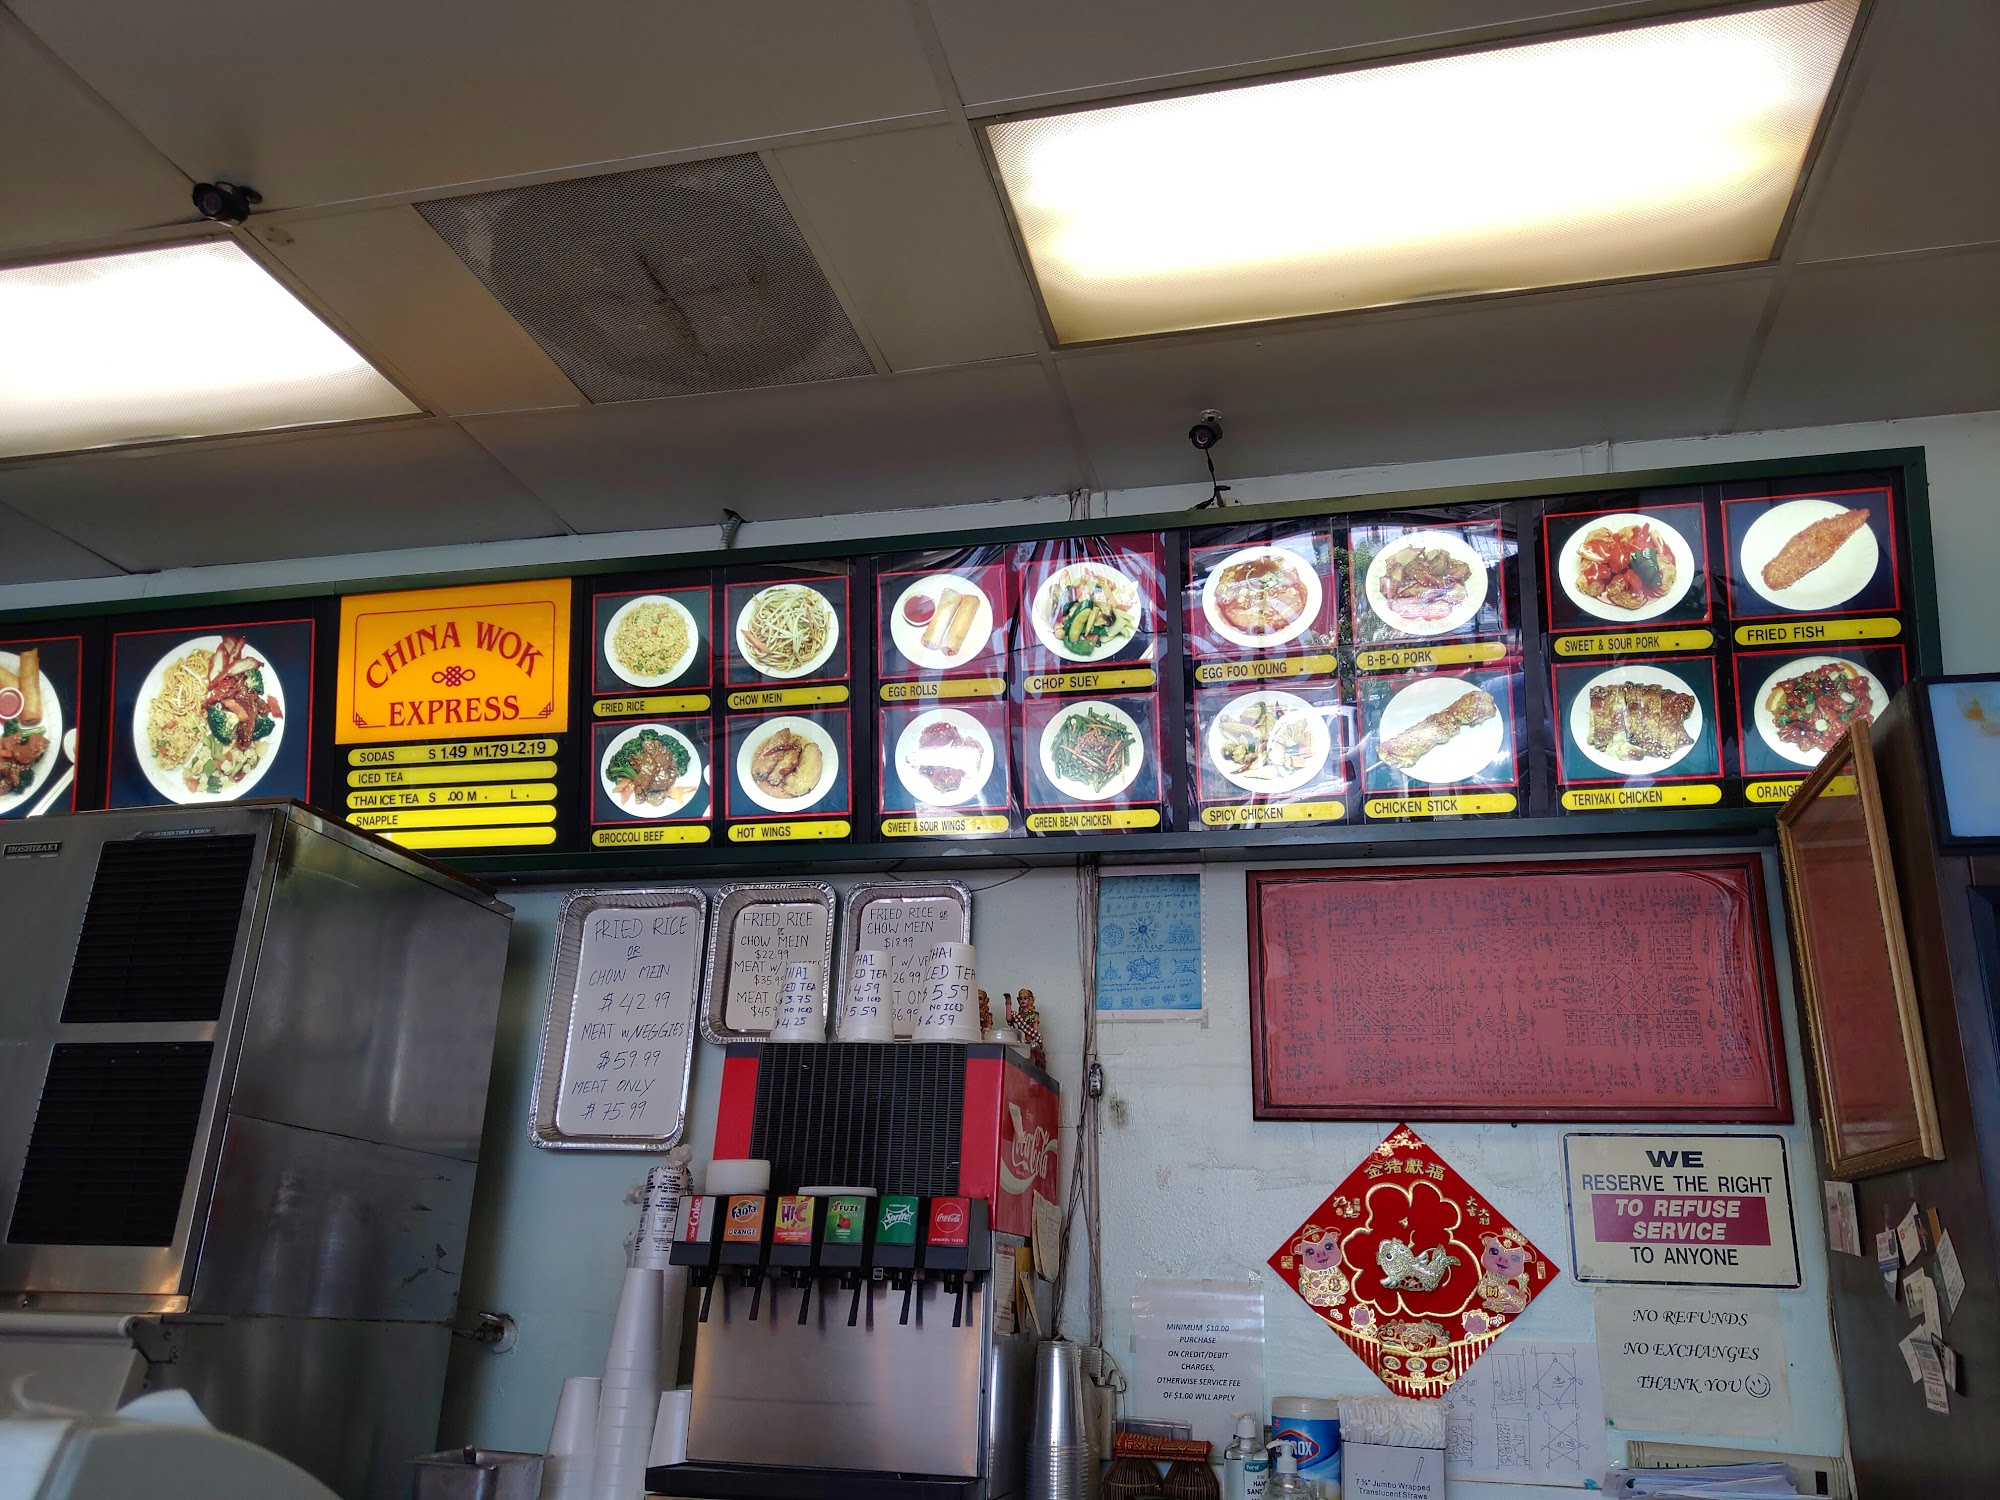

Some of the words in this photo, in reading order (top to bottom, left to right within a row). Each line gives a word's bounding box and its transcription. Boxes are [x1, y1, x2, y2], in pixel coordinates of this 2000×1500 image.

[1748, 629, 1787, 641] FRIED
[1794, 626, 1825, 638] FISH
[1565, 640, 1594, 652] SWEET
[1599, 640, 1604, 650] &
[1608, 638, 1632, 651] SOUR
[1636, 637, 1660, 648] PORK
[366, 621, 461, 688] CHINA
[476, 621, 544, 678] WOK
[1367, 654, 1399, 667] B-B-Q
[1404, 652, 1432, 663] PORK
[1202, 667, 1223, 679] EGG
[1227, 664, 1249, 677] FOO
[1253, 662, 1287, 675] YOUNG
[1034, 678, 1065, 690] CHOP
[1069, 675, 1099, 687] SUEY
[888, 686, 907, 697] EGG
[910, 685, 938, 696] ROLLS
[734, 695, 759, 706] CHOW
[762, 693, 782, 704] MEIN
[389, 695, 520, 727] EXPRESS
[601, 702, 624, 713] FRIED
[627, 701, 645, 712] RICE
[360, 751, 394, 763] SODAS
[429, 749, 436, 759] S
[441, 746, 467, 760] 1.49
[358, 773, 381, 784] ICED
[385, 772, 404, 782] TEA
[354, 796, 377, 807] THAI
[380, 795, 396, 806] ICE
[398, 794, 419, 804] TEA
[429, 792, 436, 803] S
[468, 791, 477, 801] M
[511, 789, 517, 799] L
[1572, 793, 1615, 806] TERIYAKI
[1618, 791, 1663, 805] CHICKEN
[1210, 809, 1237, 821] SPICY
[1241, 807, 1284, 820] CHICKEN
[1374, 801, 1422, 815] CHICKEN
[1427, 800, 1458, 812] STICK
[356, 815, 398, 826] SNAPPLE
[888, 822, 911, 833] SWEET
[913, 822, 918, 832] &
[919, 821, 939, 832] SOUR
[942, 820, 966, 831] WINGS
[1034, 817, 1058, 828] GREEN
[1060, 816, 1078, 827] BEAN
[1081, 815, 1112, 827] CHICKEN
[600, 832, 640, 844] BROCCOLI
[644, 831, 665, 842] BEEF
[738, 828, 755, 839] HOT
[762, 826, 791, 837] WINGS
[8, 844, 59, 853] HOSHIZAKI
[744, 912, 780, 927] FRIED
[787, 912, 813, 927] RICE
[871, 907, 903, 920] FRIED
[909, 907, 934, 918] RICE
[595, 919, 643, 942] FRIED
[653, 916, 689, 937] RICE
[868, 922, 900, 935] CHOW
[904, 921, 934, 933] MEIN
[741, 936, 771, 947] CHOW
[778, 936, 809, 948] MEIN
[755, 950, 789, 961] $22.99
[734, 961, 766, 973] MEAT
[955, 965, 976, 980] TEA
[589, 969, 627, 987] CHOW
[639, 965, 671, 979] MEIN
[870, 970, 888, 980] TEA
[800, 983, 816, 991] TEA
[737, 992, 769, 1004] MEAT
[944, 1003, 964, 1012] ICED
[581, 1024, 615, 1041] MEAT
[597, 1051, 662, 1071] $59.99
[572, 1080, 609, 1095] MEAT
[617, 1077, 656, 1097] ONLY
[1646, 1151, 1704, 1168] WE
[1582, 1174, 1665, 1192] RESERVE
[1673, 1176, 1709, 1193] THE
[1718, 1176, 1773, 1194] RIGHT
[690, 1199, 702, 1226] Coke
[732, 1205, 757, 1220] Fanta
[1616, 1199, 1644, 1217] TO
[1654, 1200, 1741, 1218] REFUSE
[885, 1213, 910, 1223] Sprite
[1633, 1222, 1727, 1241] SERVICE
[1630, 1247, 1654, 1264] TO
[1664, 1248, 1739, 1266] ANYONE
[1633, 1310, 1658, 1322] NO
[1662, 1311, 1749, 1327] REFUNDS
[1167, 1324, 1203, 1332] MINIMUM
[1181, 1351, 1229, 1359] CREDIT/DEBIT
[1624, 1343, 1649, 1355] NO
[1653, 1343, 1760, 1363] EXCHANGES
[1182, 1364, 1216, 1372] CHARGES,
[1157, 1377, 1198, 1385] OTHERWISE
[1637, 1376, 1703, 1394] THANK
[1704, 1379, 1742, 1393] YOU
[1174, 1392, 1193, 1400] $1.00
[1195, 1393, 1211, 1401] WILL
[1359, 1487, 1401, 1498] Translucent
[1403, 1490, 1428, 1500] Straws
[1373, 1481, 1397, 1489] Jumbo
[1399, 1483, 1431, 1492] Wrapped
